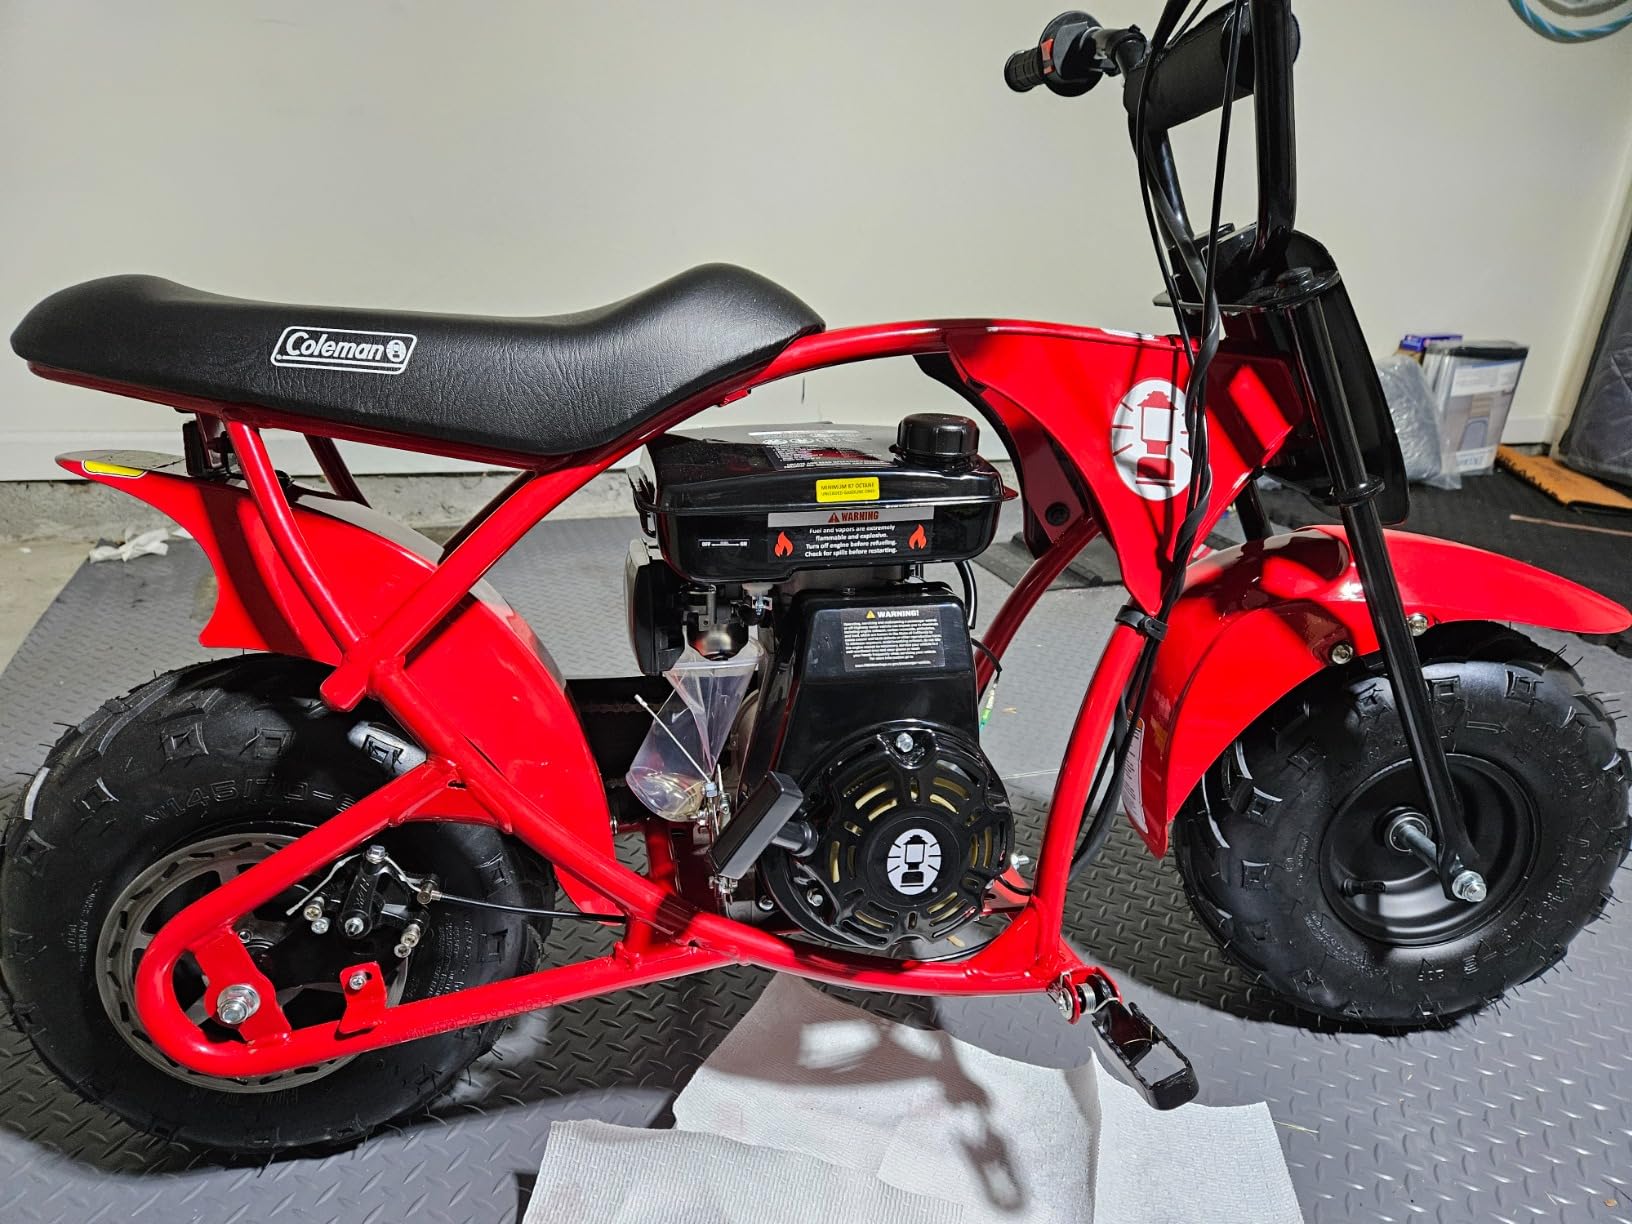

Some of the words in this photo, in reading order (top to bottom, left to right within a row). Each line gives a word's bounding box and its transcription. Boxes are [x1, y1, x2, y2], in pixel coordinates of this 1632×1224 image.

[286, 331, 385, 361] Coleman
[841, 511, 879, 521] WARNING
[829, 541, 849, 549] engine
[833, 549, 848, 557] spills
[877, 610, 919, 618] WARNING!
